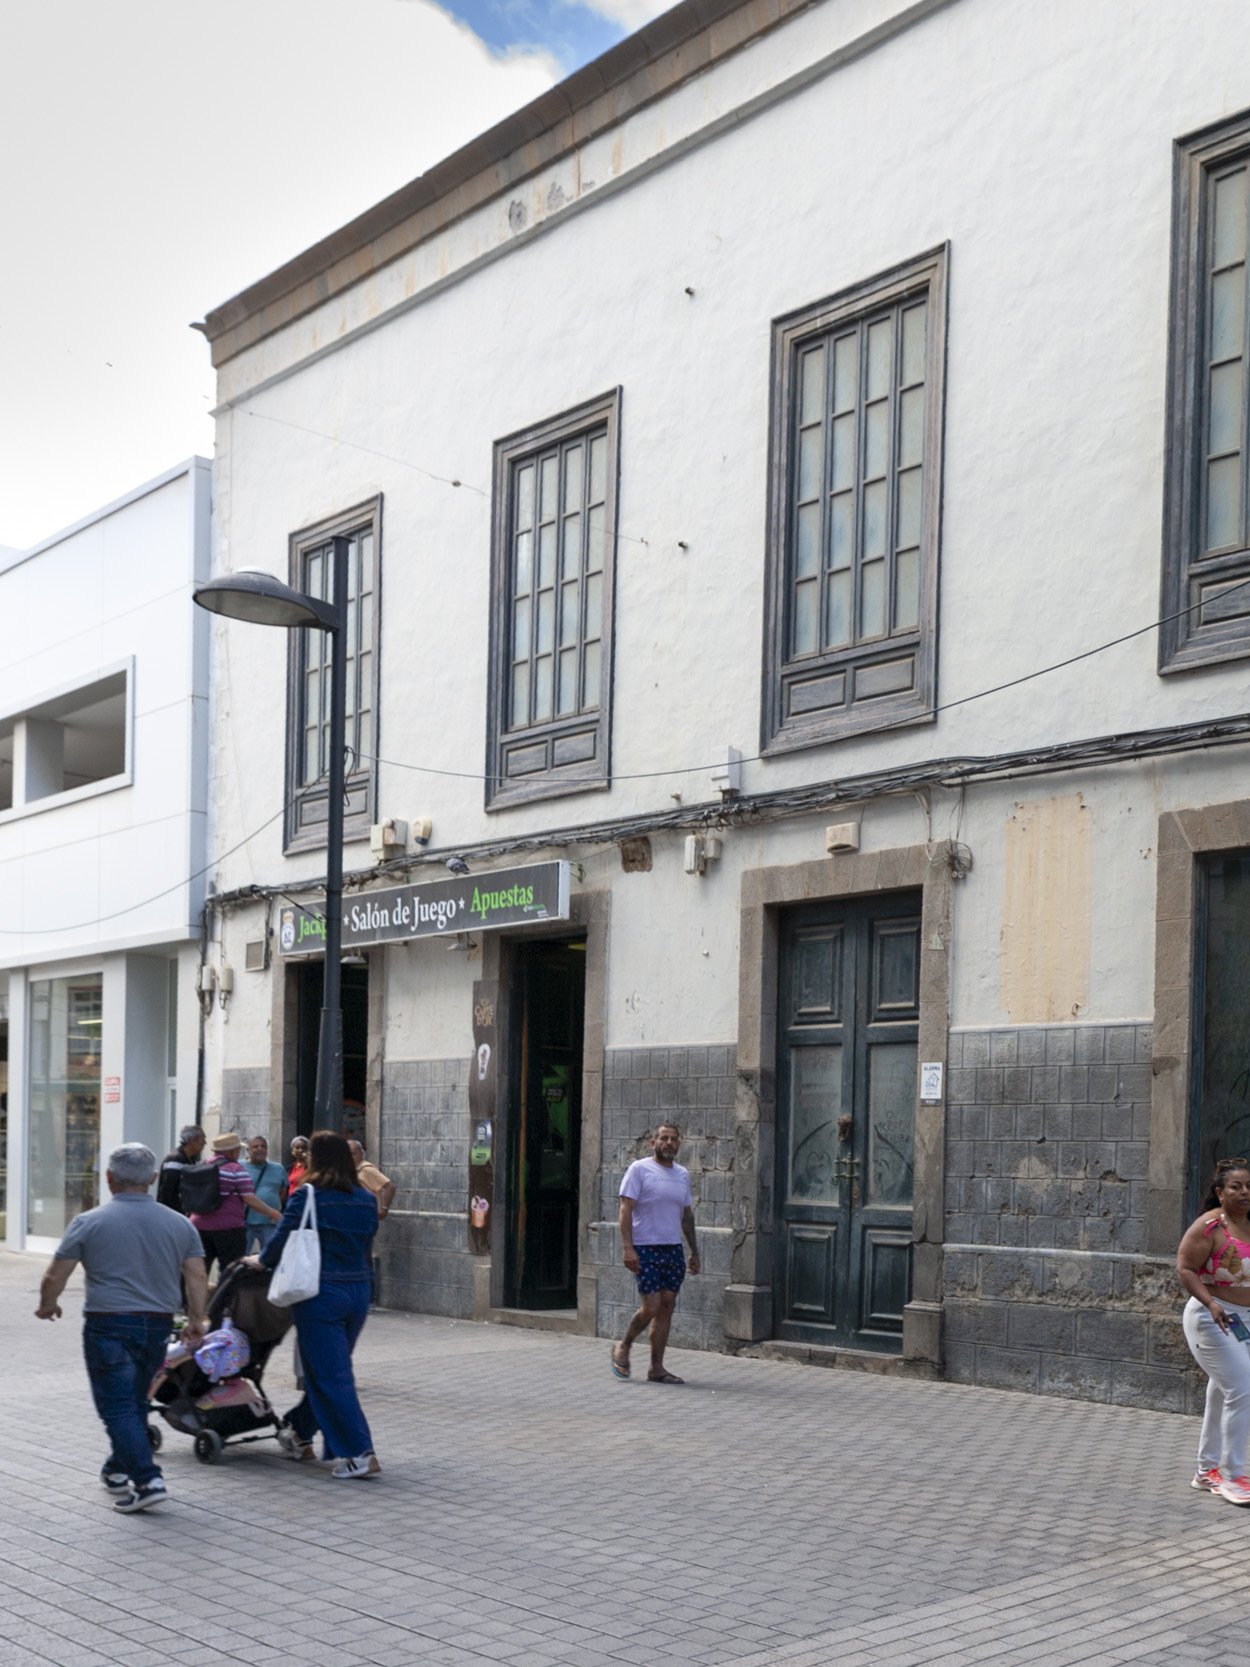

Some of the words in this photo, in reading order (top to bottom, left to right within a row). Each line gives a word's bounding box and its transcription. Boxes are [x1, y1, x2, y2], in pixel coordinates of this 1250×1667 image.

[351, 902, 390, 932] Salón
[392, 898, 410, 925] de
[411, 896, 456, 931] Juego
[470, 884, 534, 919] Apuestas
